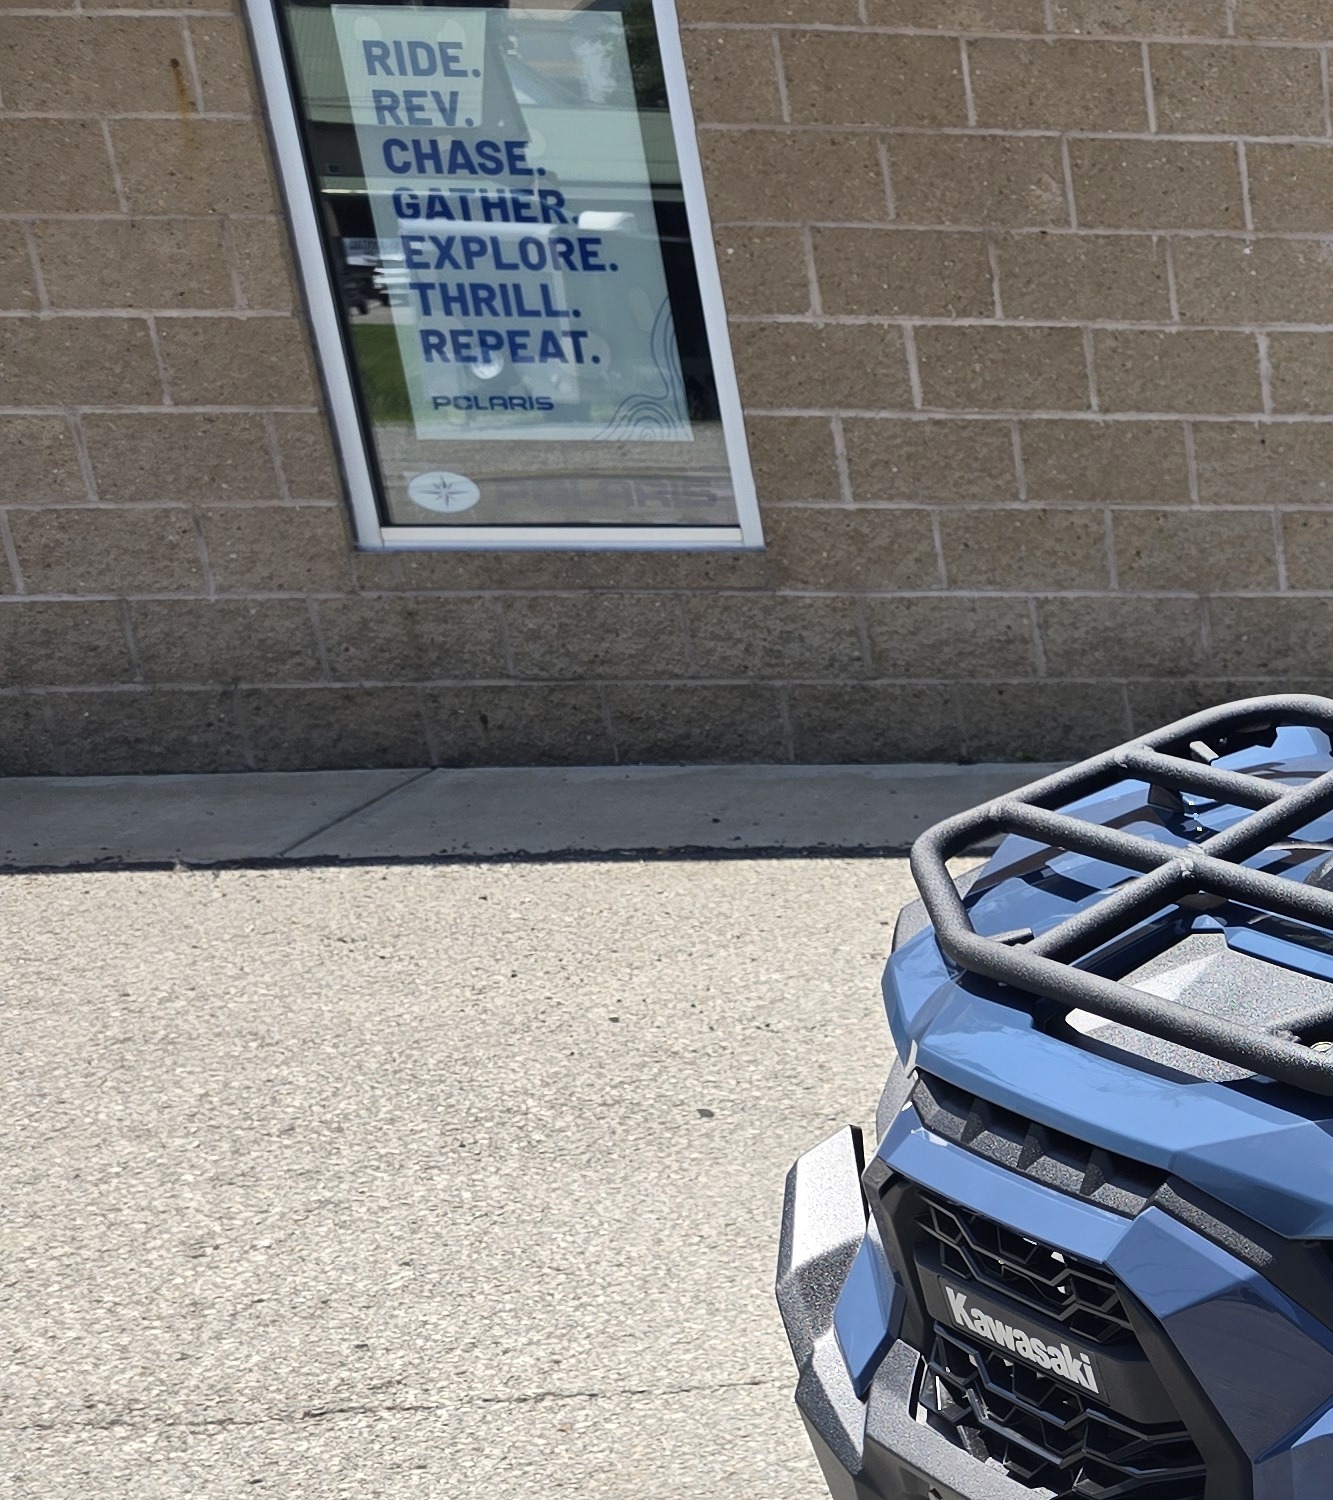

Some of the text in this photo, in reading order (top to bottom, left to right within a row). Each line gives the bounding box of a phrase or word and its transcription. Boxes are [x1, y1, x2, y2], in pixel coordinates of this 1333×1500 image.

[362, 40, 481, 78] RIDE.
[372, 90, 474, 127] REV.
[382, 138, 546, 177] CHASE.
[392, 187, 579, 225] GATHER.
[401, 236, 619, 273] EXPLORE.
[409, 282, 581, 319] THRILL.
[419, 329, 600, 365] REPEAT.
[431, 395, 555, 411] POLARIS
[945, 1285, 1101, 1396] Kawasaki
